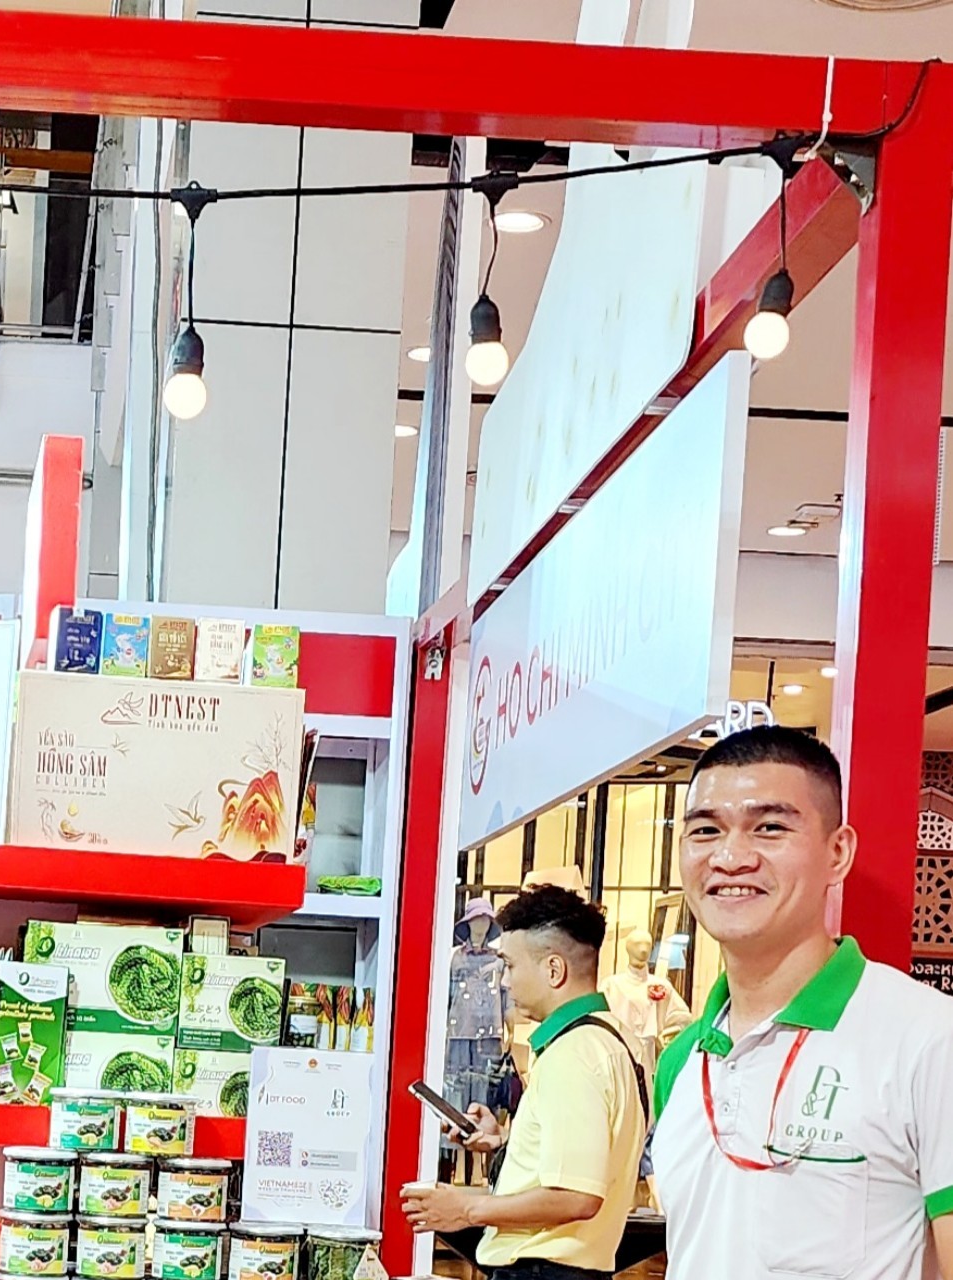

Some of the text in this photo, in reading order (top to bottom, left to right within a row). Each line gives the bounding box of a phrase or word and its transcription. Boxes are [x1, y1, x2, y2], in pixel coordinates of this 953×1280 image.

[495, 661, 523, 750] HO
[527, 625, 563, 726] CHI
[281, 1095, 307, 1105] FOOD
[785, 1125, 844, 1143] GROUP
